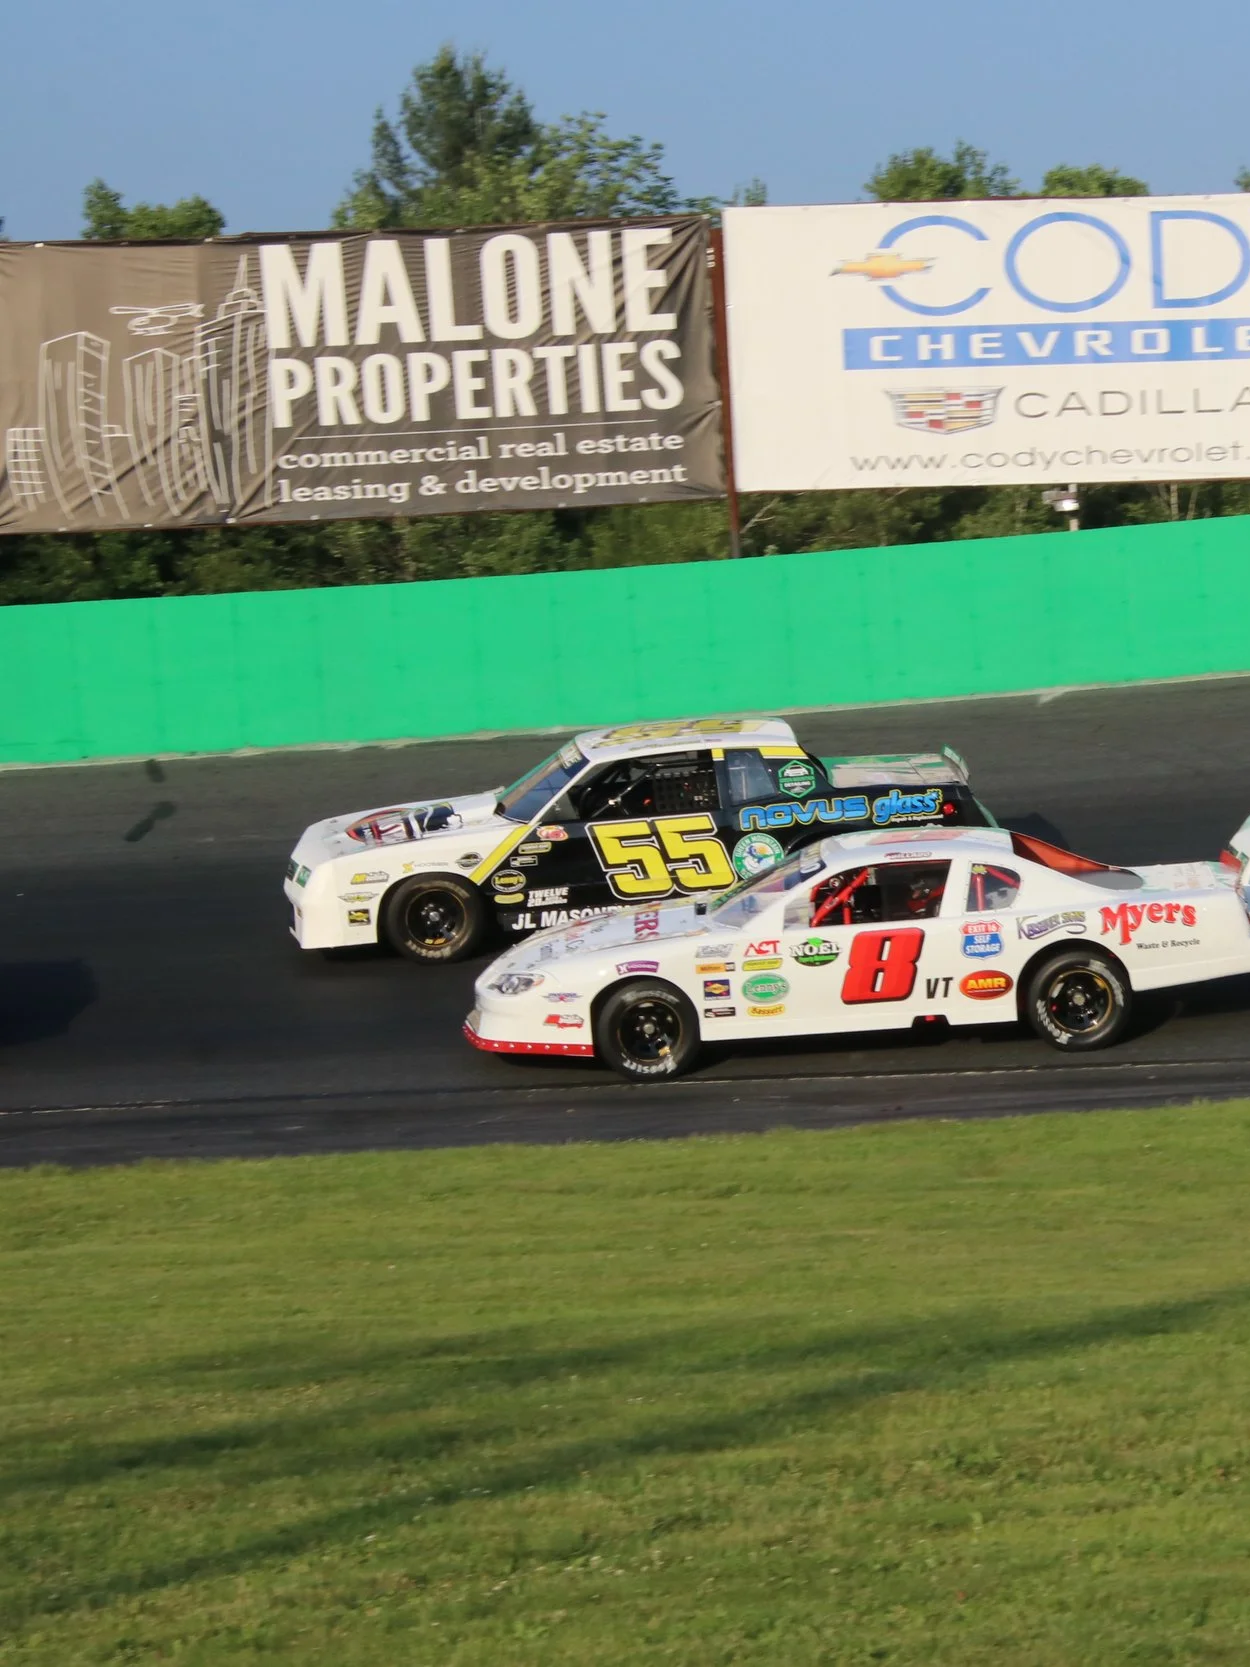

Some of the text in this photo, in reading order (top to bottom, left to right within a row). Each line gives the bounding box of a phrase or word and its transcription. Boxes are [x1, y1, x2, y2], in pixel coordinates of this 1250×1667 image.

[259, 228, 677, 349] MALONE
[271, 340, 685, 428] PROPERTIES
[277, 433, 685, 469] commercial real estate
[278, 464, 688, 503] leasing & development
[586, 813, 738, 899] 55
[528, 887, 569, 899] TWELVE
[512, 905, 633, 931] JL MASON
[967, 924, 987, 933] EXIT
[1098, 903, 1197, 945] Myers
[743, 940, 782, 957] ACT
[789, 942, 842, 957] NOEL
[965, 943, 1001, 953] STORAGE
[974, 934, 991, 943] SELF
[1170, 939, 1201, 947] Recycle
[840, 927, 926, 1005] 8
[926, 976, 954, 1000] VT
[967, 977, 1007, 990] AMR
